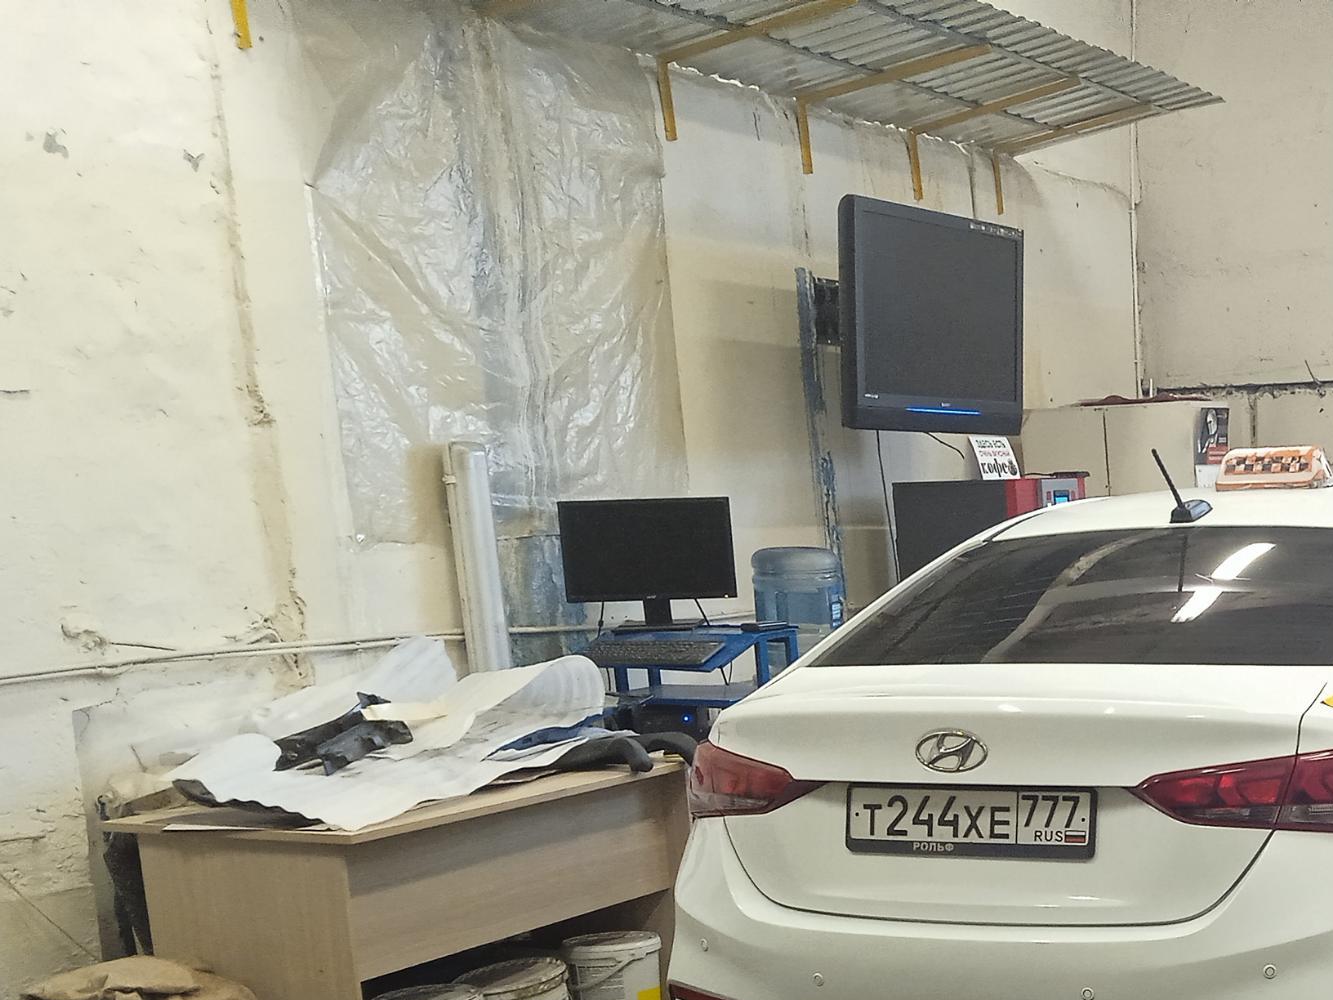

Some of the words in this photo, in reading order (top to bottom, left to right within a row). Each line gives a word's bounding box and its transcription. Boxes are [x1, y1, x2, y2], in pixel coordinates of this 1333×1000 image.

[1021, 794, 1082, 829] 777
[1034, 830, 1064, 843] RUS
[912, 841, 955, 852] РОЛЬФ
